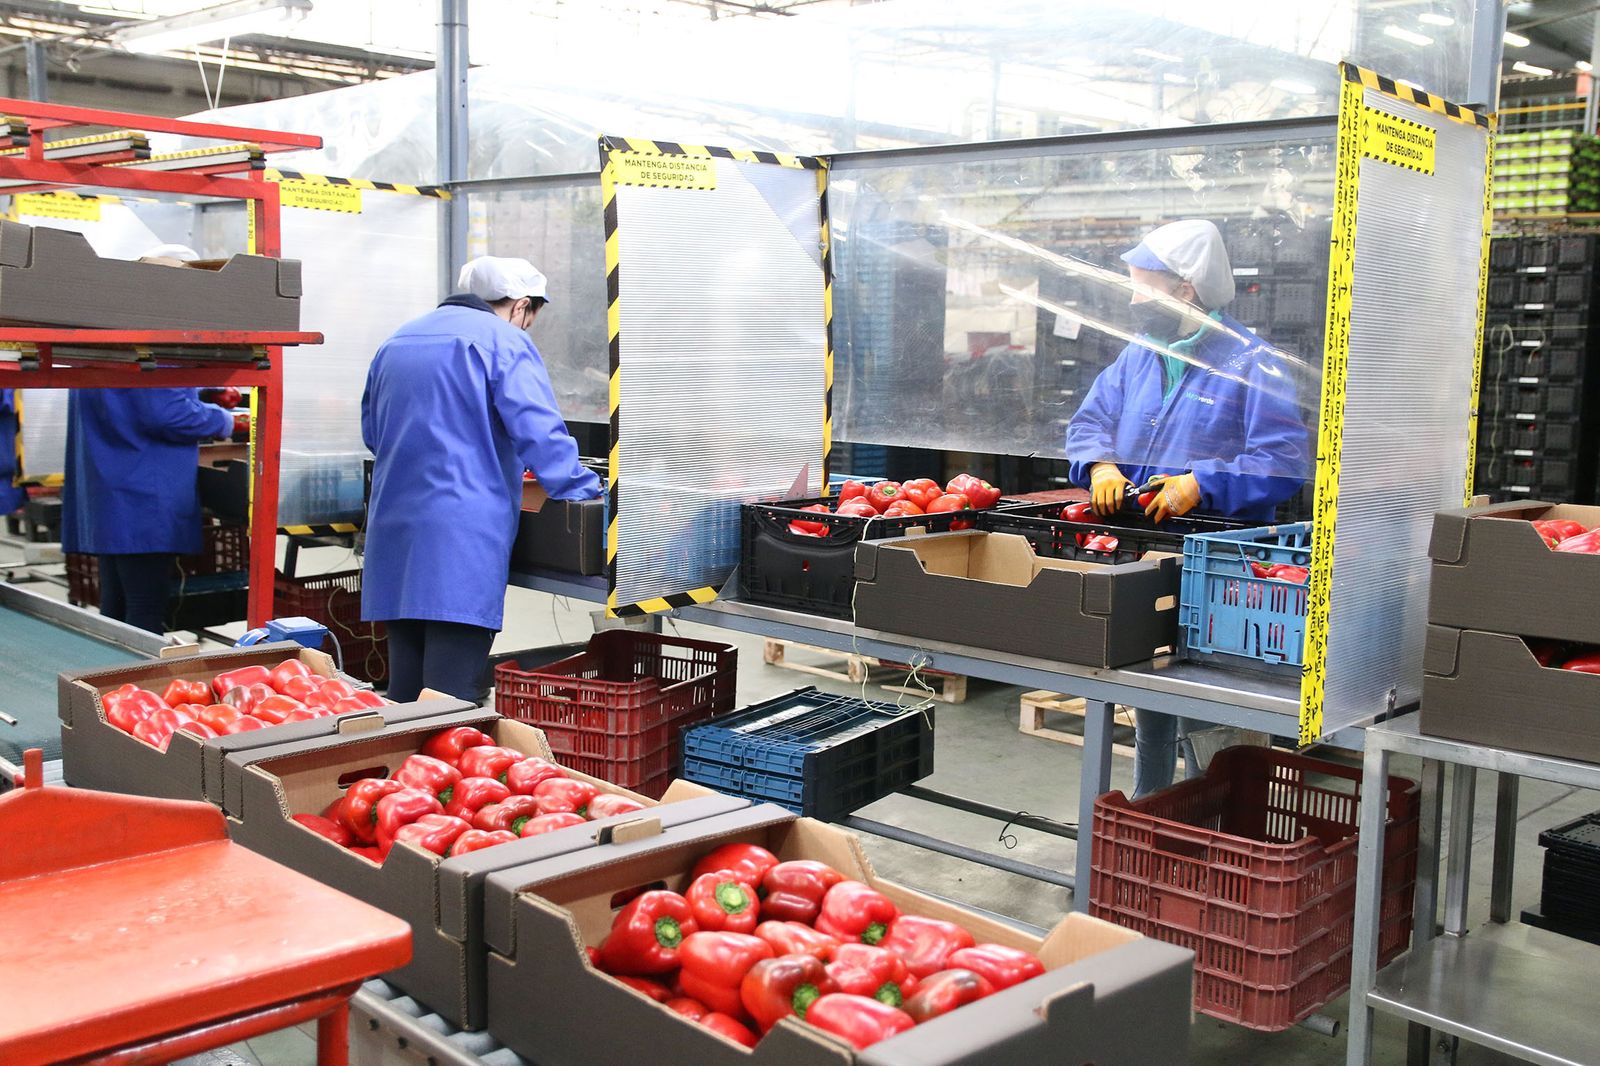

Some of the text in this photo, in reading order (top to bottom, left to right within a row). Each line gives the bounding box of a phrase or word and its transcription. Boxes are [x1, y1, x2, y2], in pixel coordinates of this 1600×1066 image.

[625, 159, 707, 171] MANTENGA DISTANCIA
[1376, 122, 1434, 149] MANTENGA DISTANCIA
[1385, 141, 1424, 161] DE SEGURIDAD
[281, 186, 356, 198] MANTENGA DISTANCIA
[640, 171, 695, 181] DE SEGURIDAD
[1337, 135, 1346, 213] DISTANCIA
[1345, 98, 1360, 262] MANTENGA DISTANCIA
[1323, 270, 1338, 433] MANTENGA DISTANCIA
[1474, 325, 1482, 393] MANTENGA
[1330, 317, 1346, 476] MANTENGA DISTANCIA
[1314, 486, 1324, 565] MANTENGA
[1305, 569, 1319, 644] DISTANCIA
[1315, 529, 1331, 684] MANTENGA DISTANCIA
